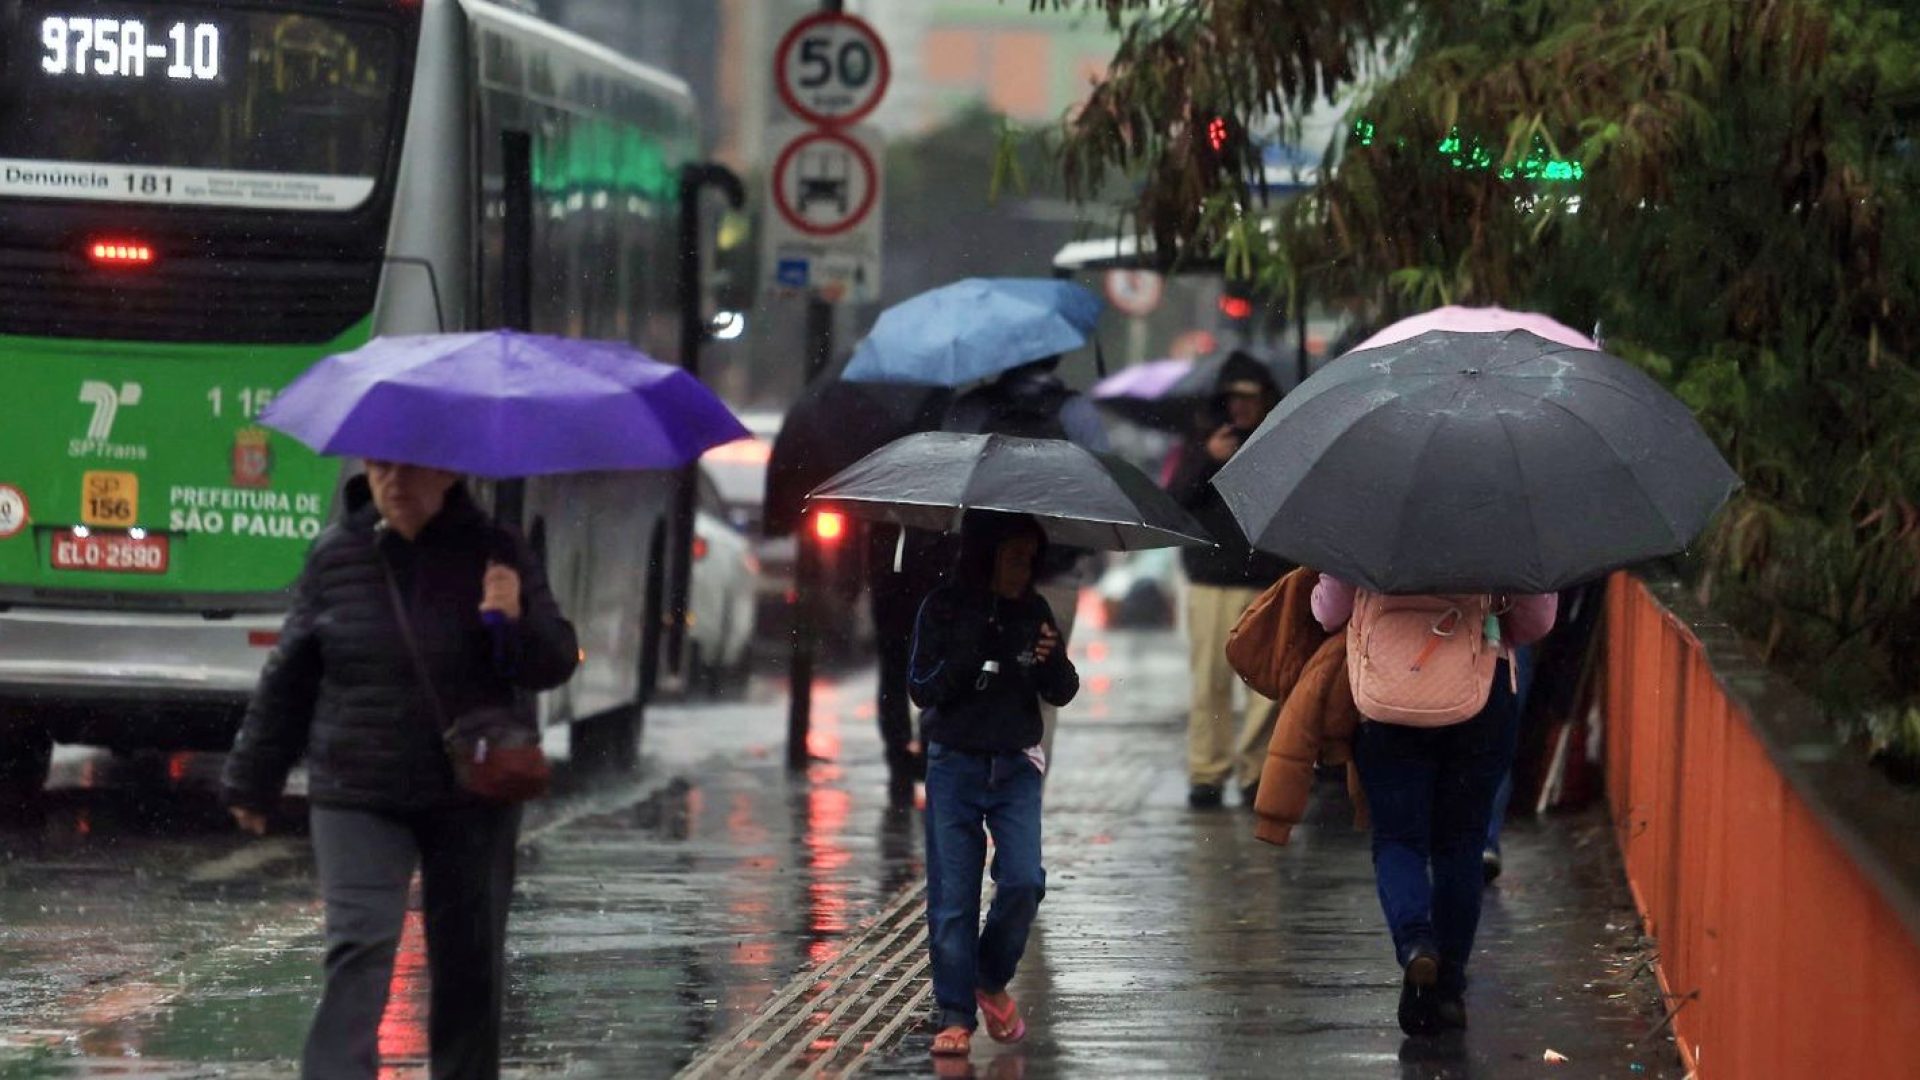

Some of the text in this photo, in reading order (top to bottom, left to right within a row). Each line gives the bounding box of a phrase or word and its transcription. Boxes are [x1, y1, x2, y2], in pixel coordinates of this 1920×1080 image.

[41, 16, 220, 80] 975A-10
[799, 38, 873, 88] 50
[5, 166, 109, 188] Denúncia
[124, 174, 174, 194] 181
[207, 387, 221, 417] 1
[68, 439, 148, 459] SPTrans
[90, 477, 119, 494] SP
[89, 498, 131, 519] 156
[170, 486, 321, 514] PREFEITURA DE
[169, 508, 321, 540] SÃO PAULO
